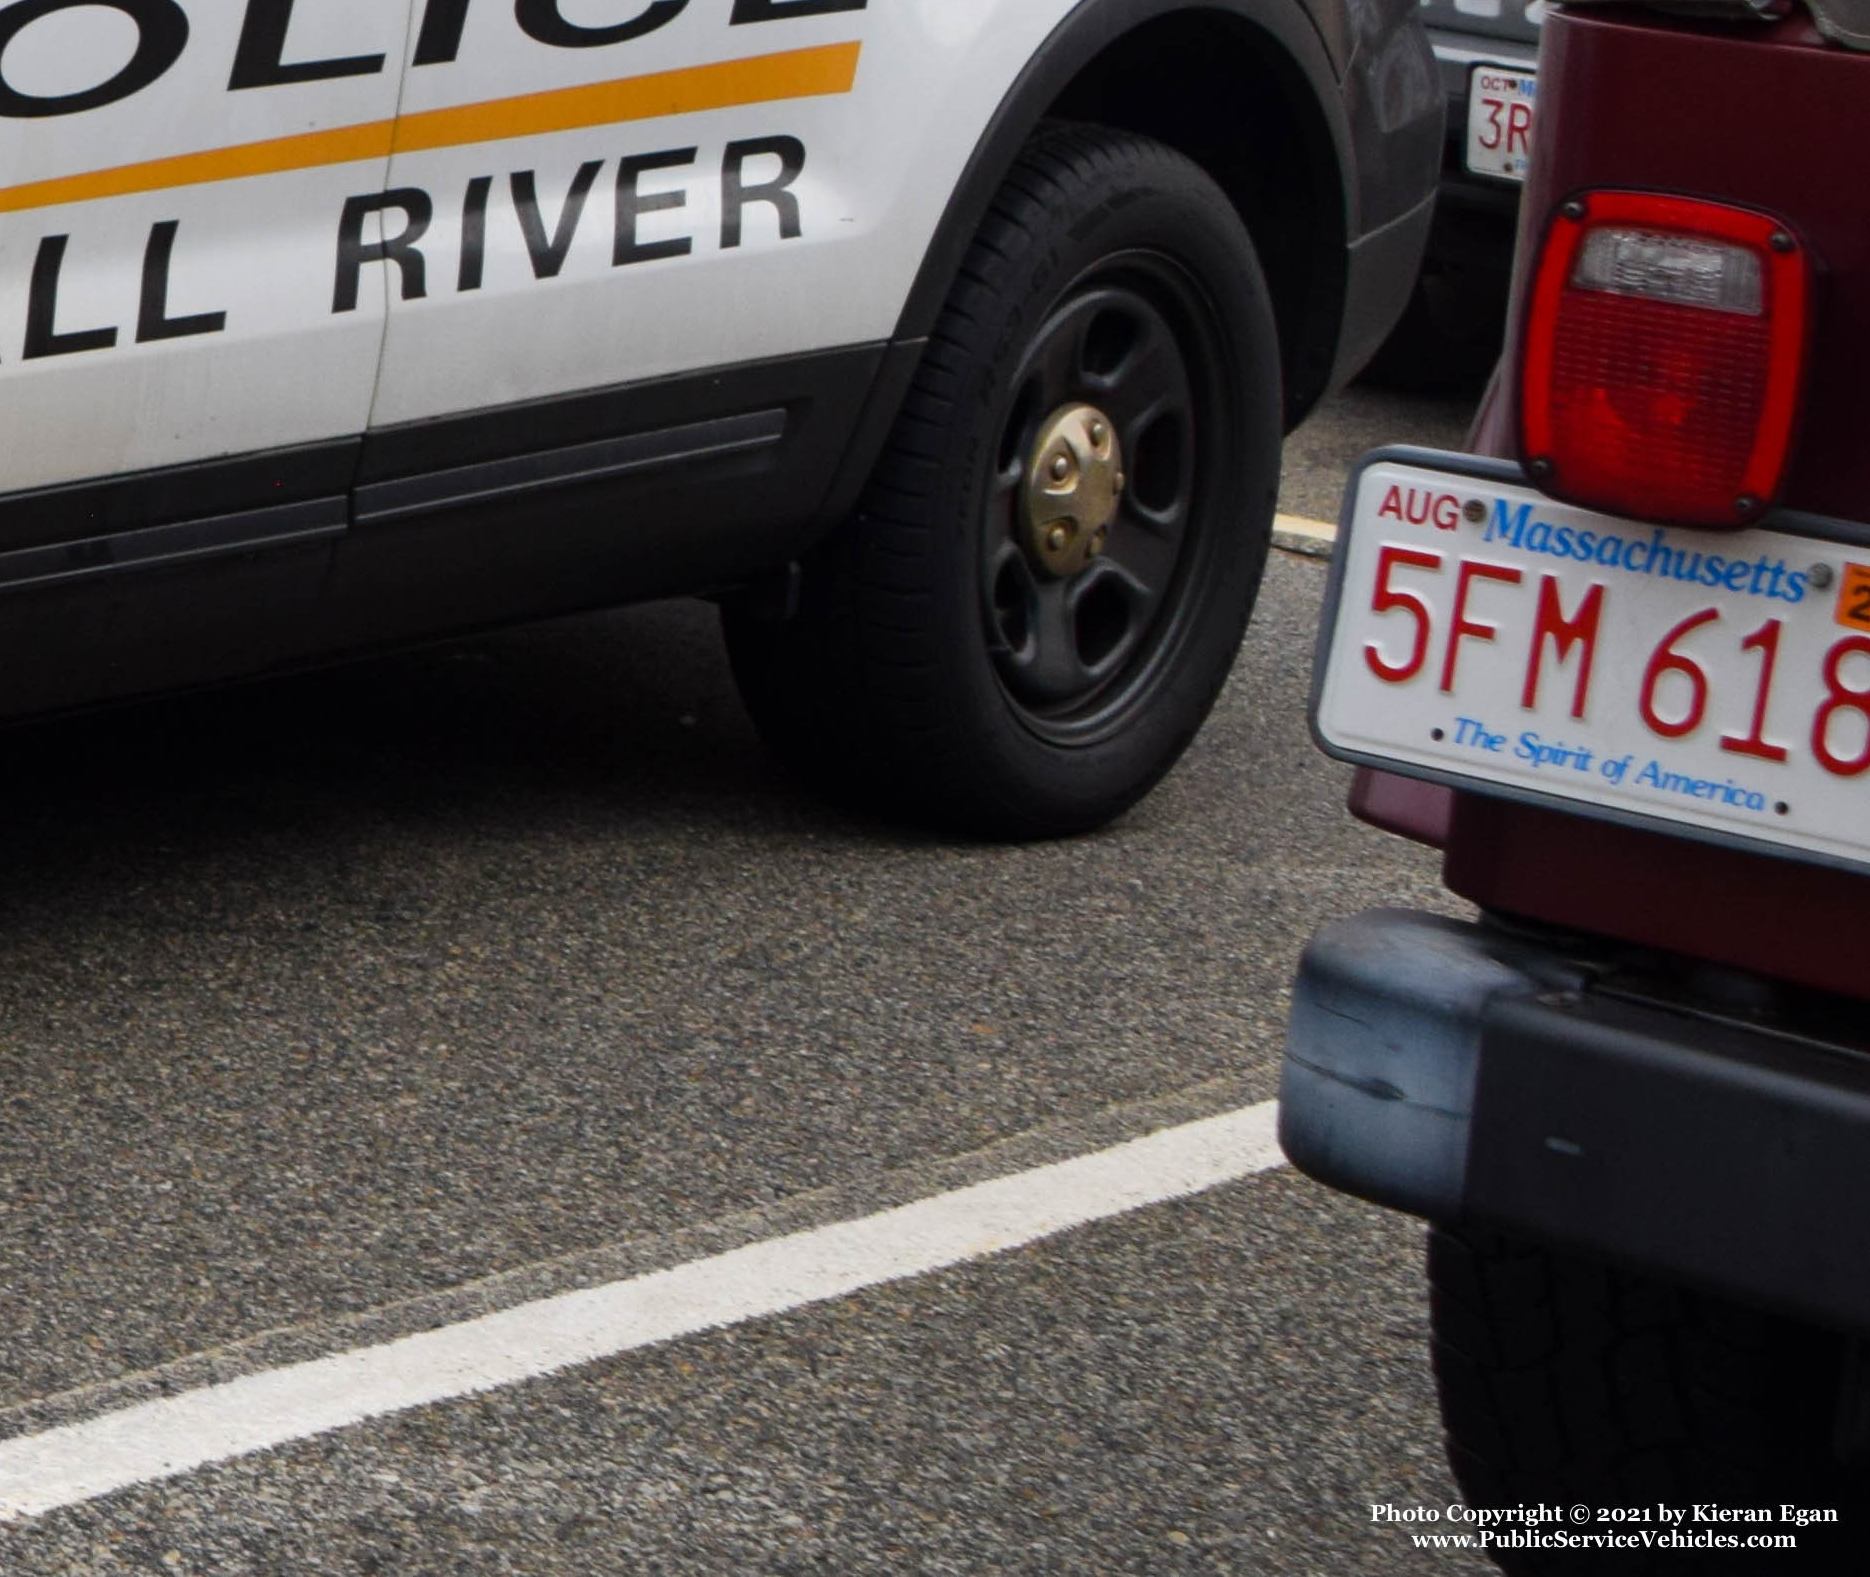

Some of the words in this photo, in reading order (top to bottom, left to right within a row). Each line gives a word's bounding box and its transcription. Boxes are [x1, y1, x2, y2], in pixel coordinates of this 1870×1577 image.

[1481, 76, 1511, 91] OCT
[331, 133, 807, 313] RIVER
[1378, 485, 1460, 532] AUG
[1483, 496, 1807, 604] Massachusetts
[1364, 546, 1605, 719] 5FM
[1639, 607, 1870, 777] 618
[1454, 717, 1507, 752] The
[1514, 731, 1594, 772] Spirit
[1601, 755, 1631, 786] of
[1636, 760, 1765, 812] America
